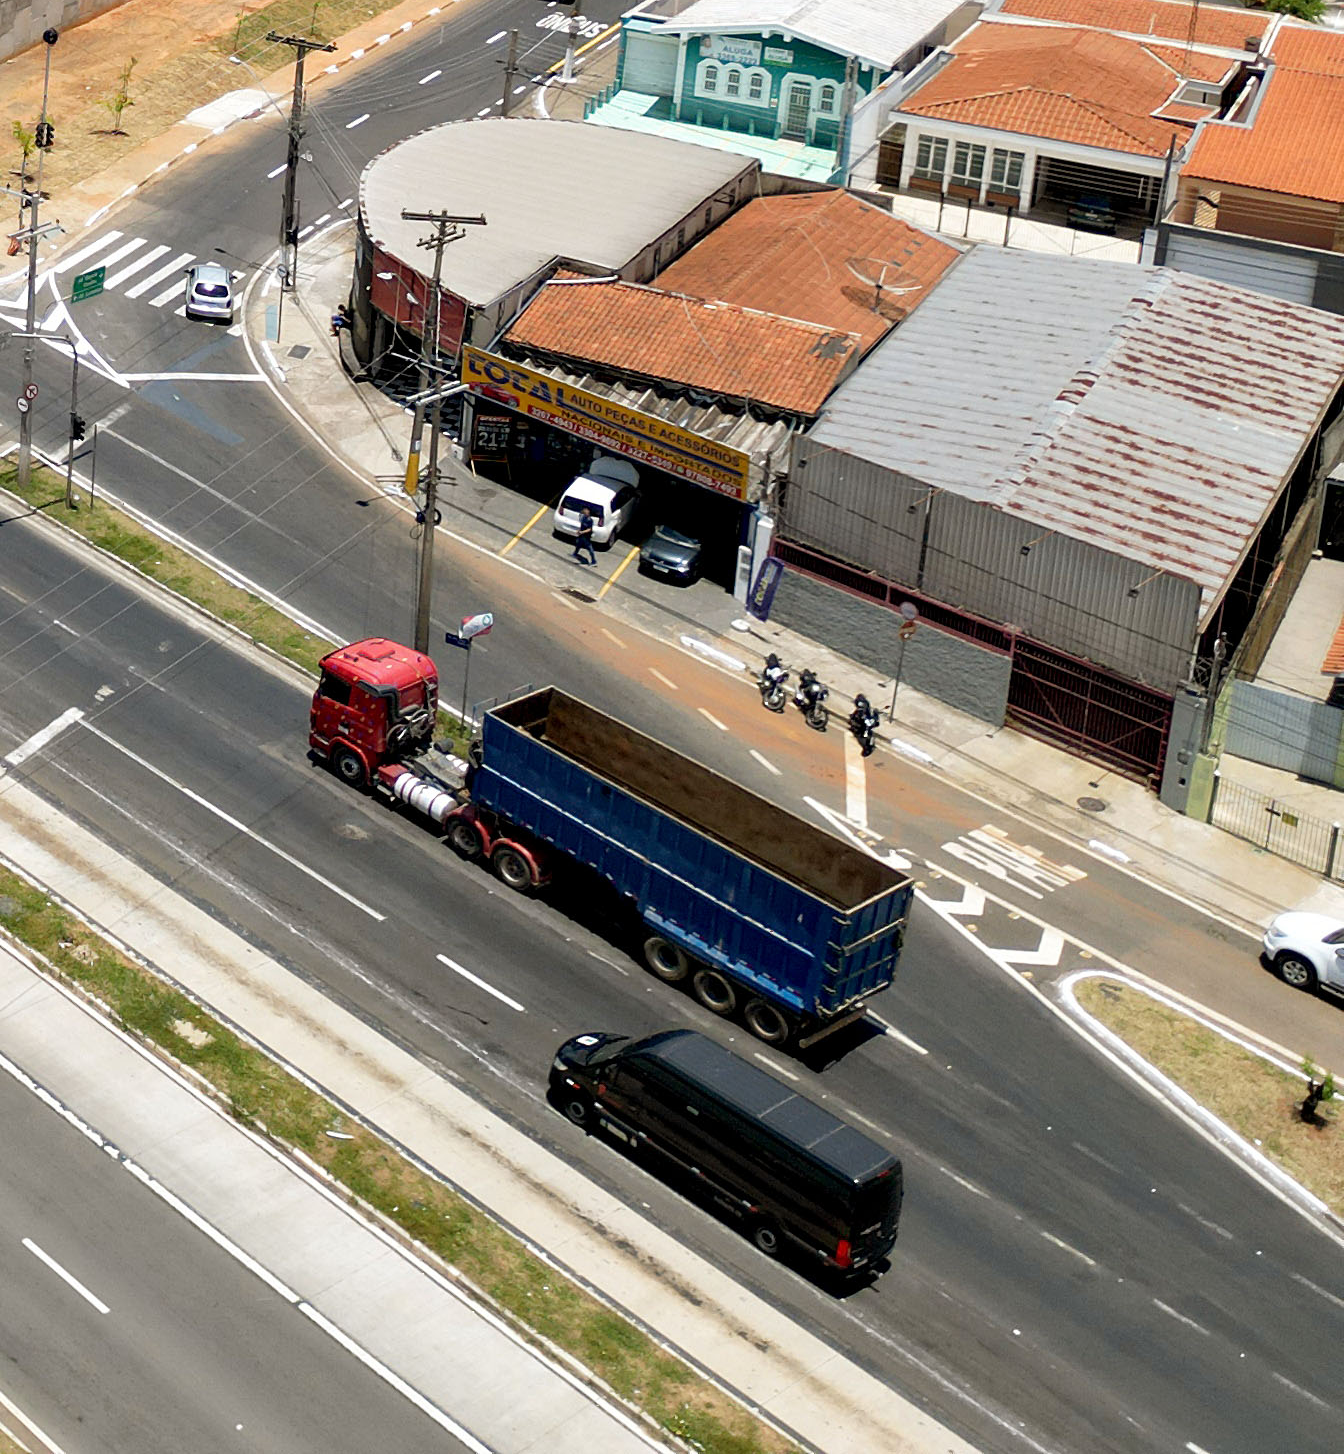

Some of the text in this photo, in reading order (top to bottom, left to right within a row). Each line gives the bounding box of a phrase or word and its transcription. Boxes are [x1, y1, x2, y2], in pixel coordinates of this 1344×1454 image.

[723, 45, 753, 56] ALUGA
[562, 410, 634, 445] NACIONAIS
[651, 445, 742, 487] IMPORTADOS
[571, 394, 740, 468] AUTO PEÇAS E ACESSÓRIOS
[941, 824, 1088, 900] PARE
